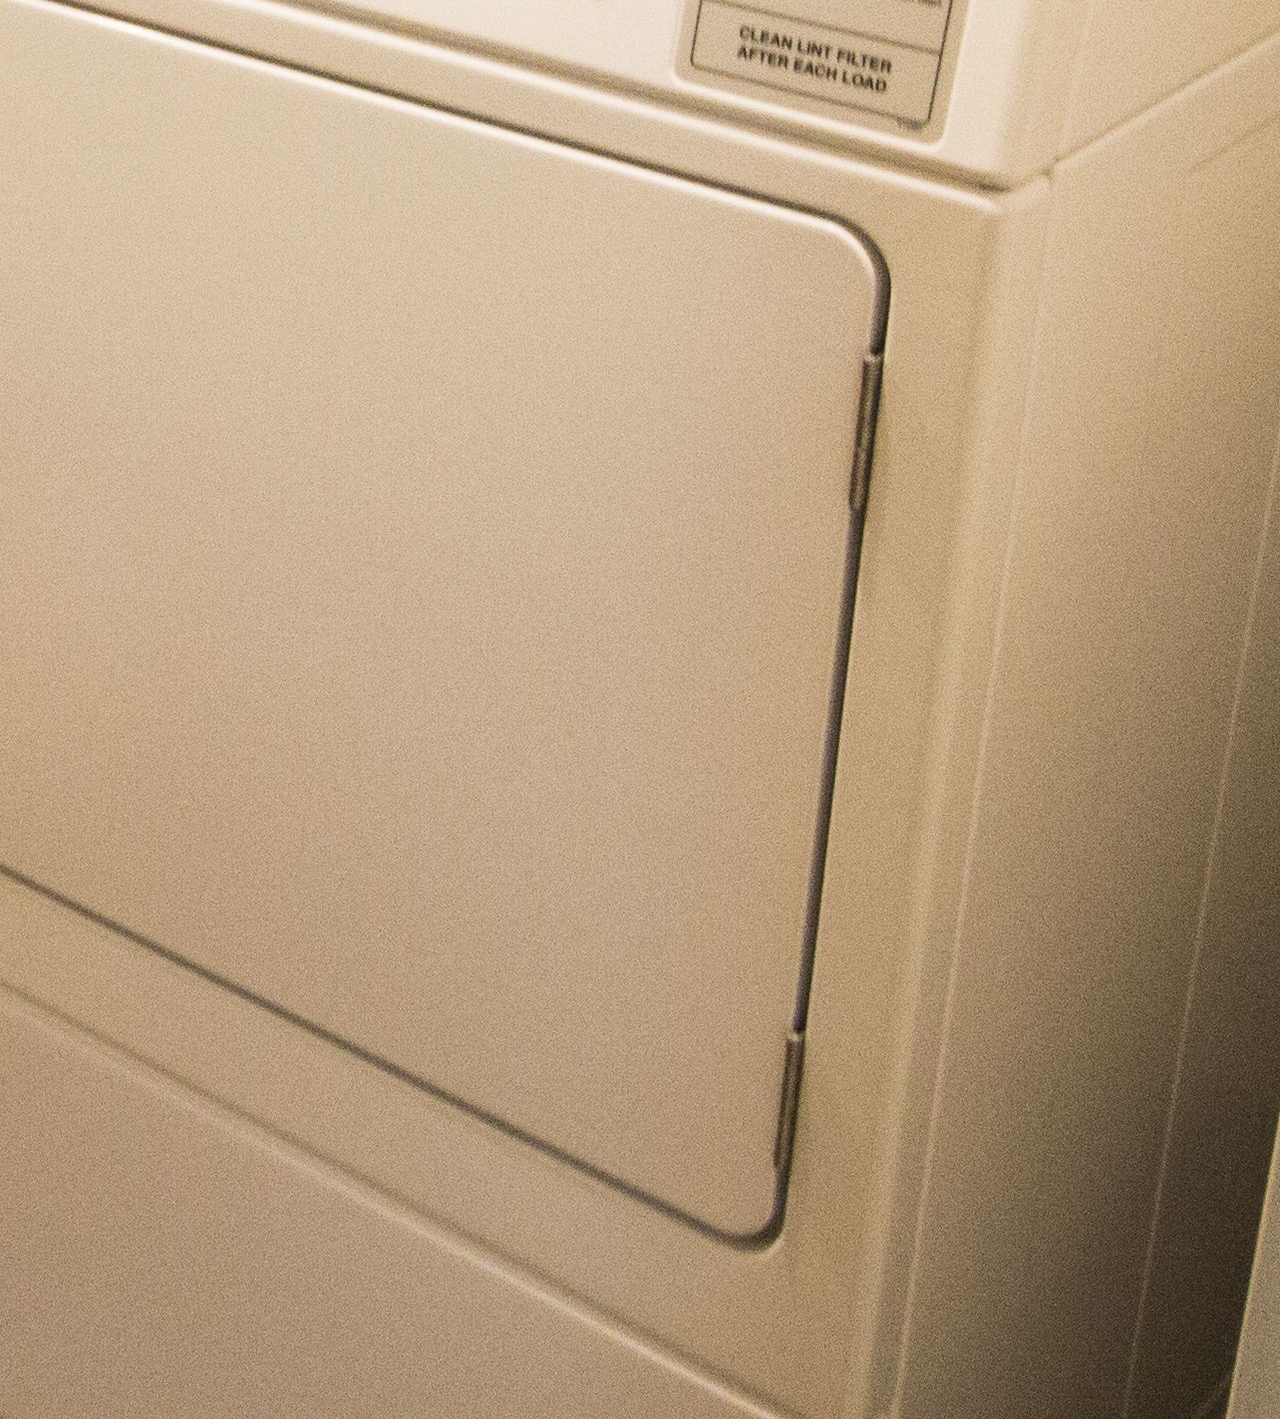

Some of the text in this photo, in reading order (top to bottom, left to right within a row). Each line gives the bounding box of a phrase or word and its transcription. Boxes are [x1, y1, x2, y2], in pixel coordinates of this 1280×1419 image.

[737, 45, 887, 93] AFTER EACH LOAD
[739, 25, 892, 75] CLEAN LINT FILTER
